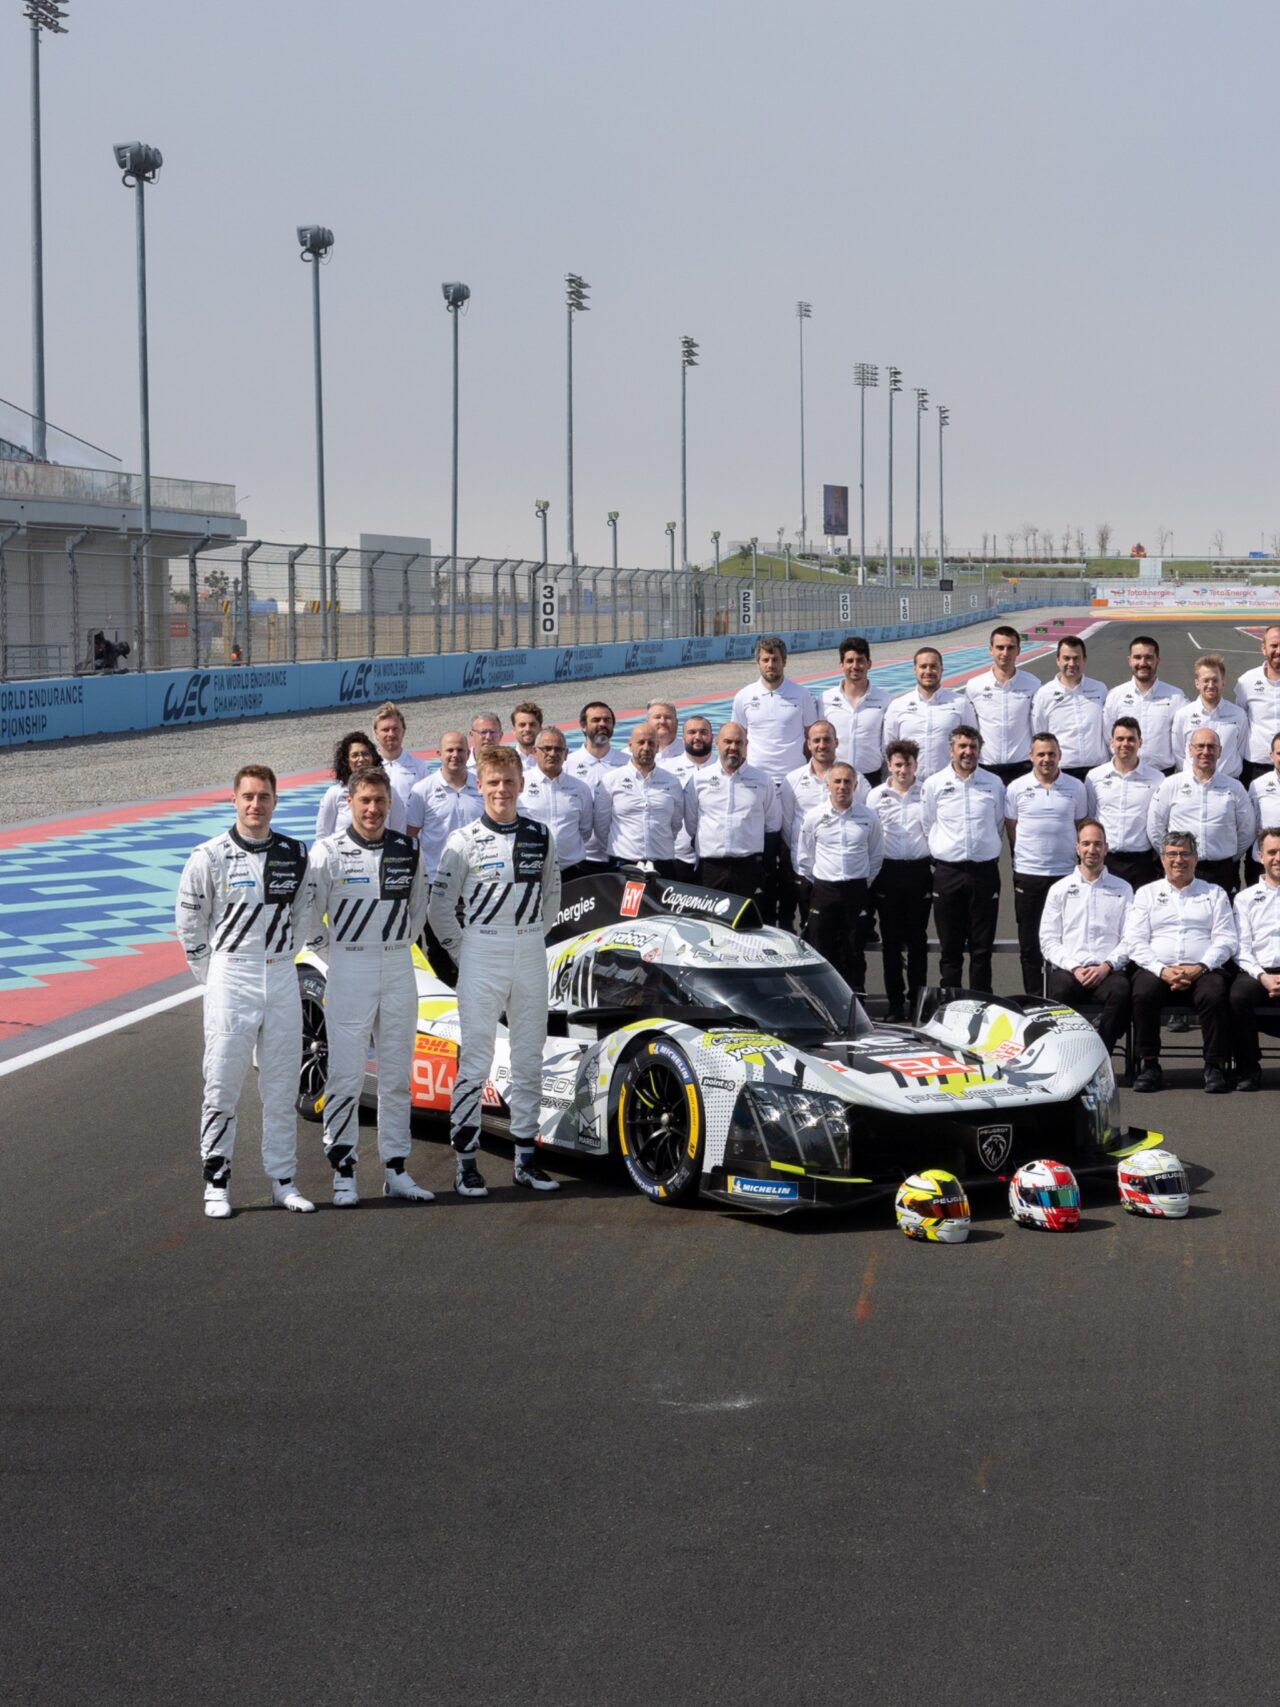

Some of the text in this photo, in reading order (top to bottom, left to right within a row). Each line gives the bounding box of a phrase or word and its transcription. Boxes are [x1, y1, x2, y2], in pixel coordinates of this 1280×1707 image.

[543, 585, 554, 632] 300
[743, 592, 751, 624] 250
[214, 670, 287, 690] FIA WORLD ENDURANCE
[339, 663, 372, 702] WEC
[462, 655, 487, 689] WEC
[29, 685, 83, 709] ENDURANCE
[163, 674, 211, 721] WEC
[214, 694, 263, 713] CHAMPIONSHIP
[551, 896, 596, 926] nergies
[622, 887, 642, 911] HY
[661, 886, 716, 914] Capgemini
[416, 1037, 450, 1053] DHL
[728, 1044, 788, 1061] yahoo!
[659, 1045, 689, 1080] MICHELIN
[889, 1058, 970, 1075] 94
[413, 1059, 453, 1101] 94
[703, 1078, 724, 1088] point
[905, 1084, 1052, 1103] PEUGEOT
[742, 1184, 792, 1194] MICHELIN
